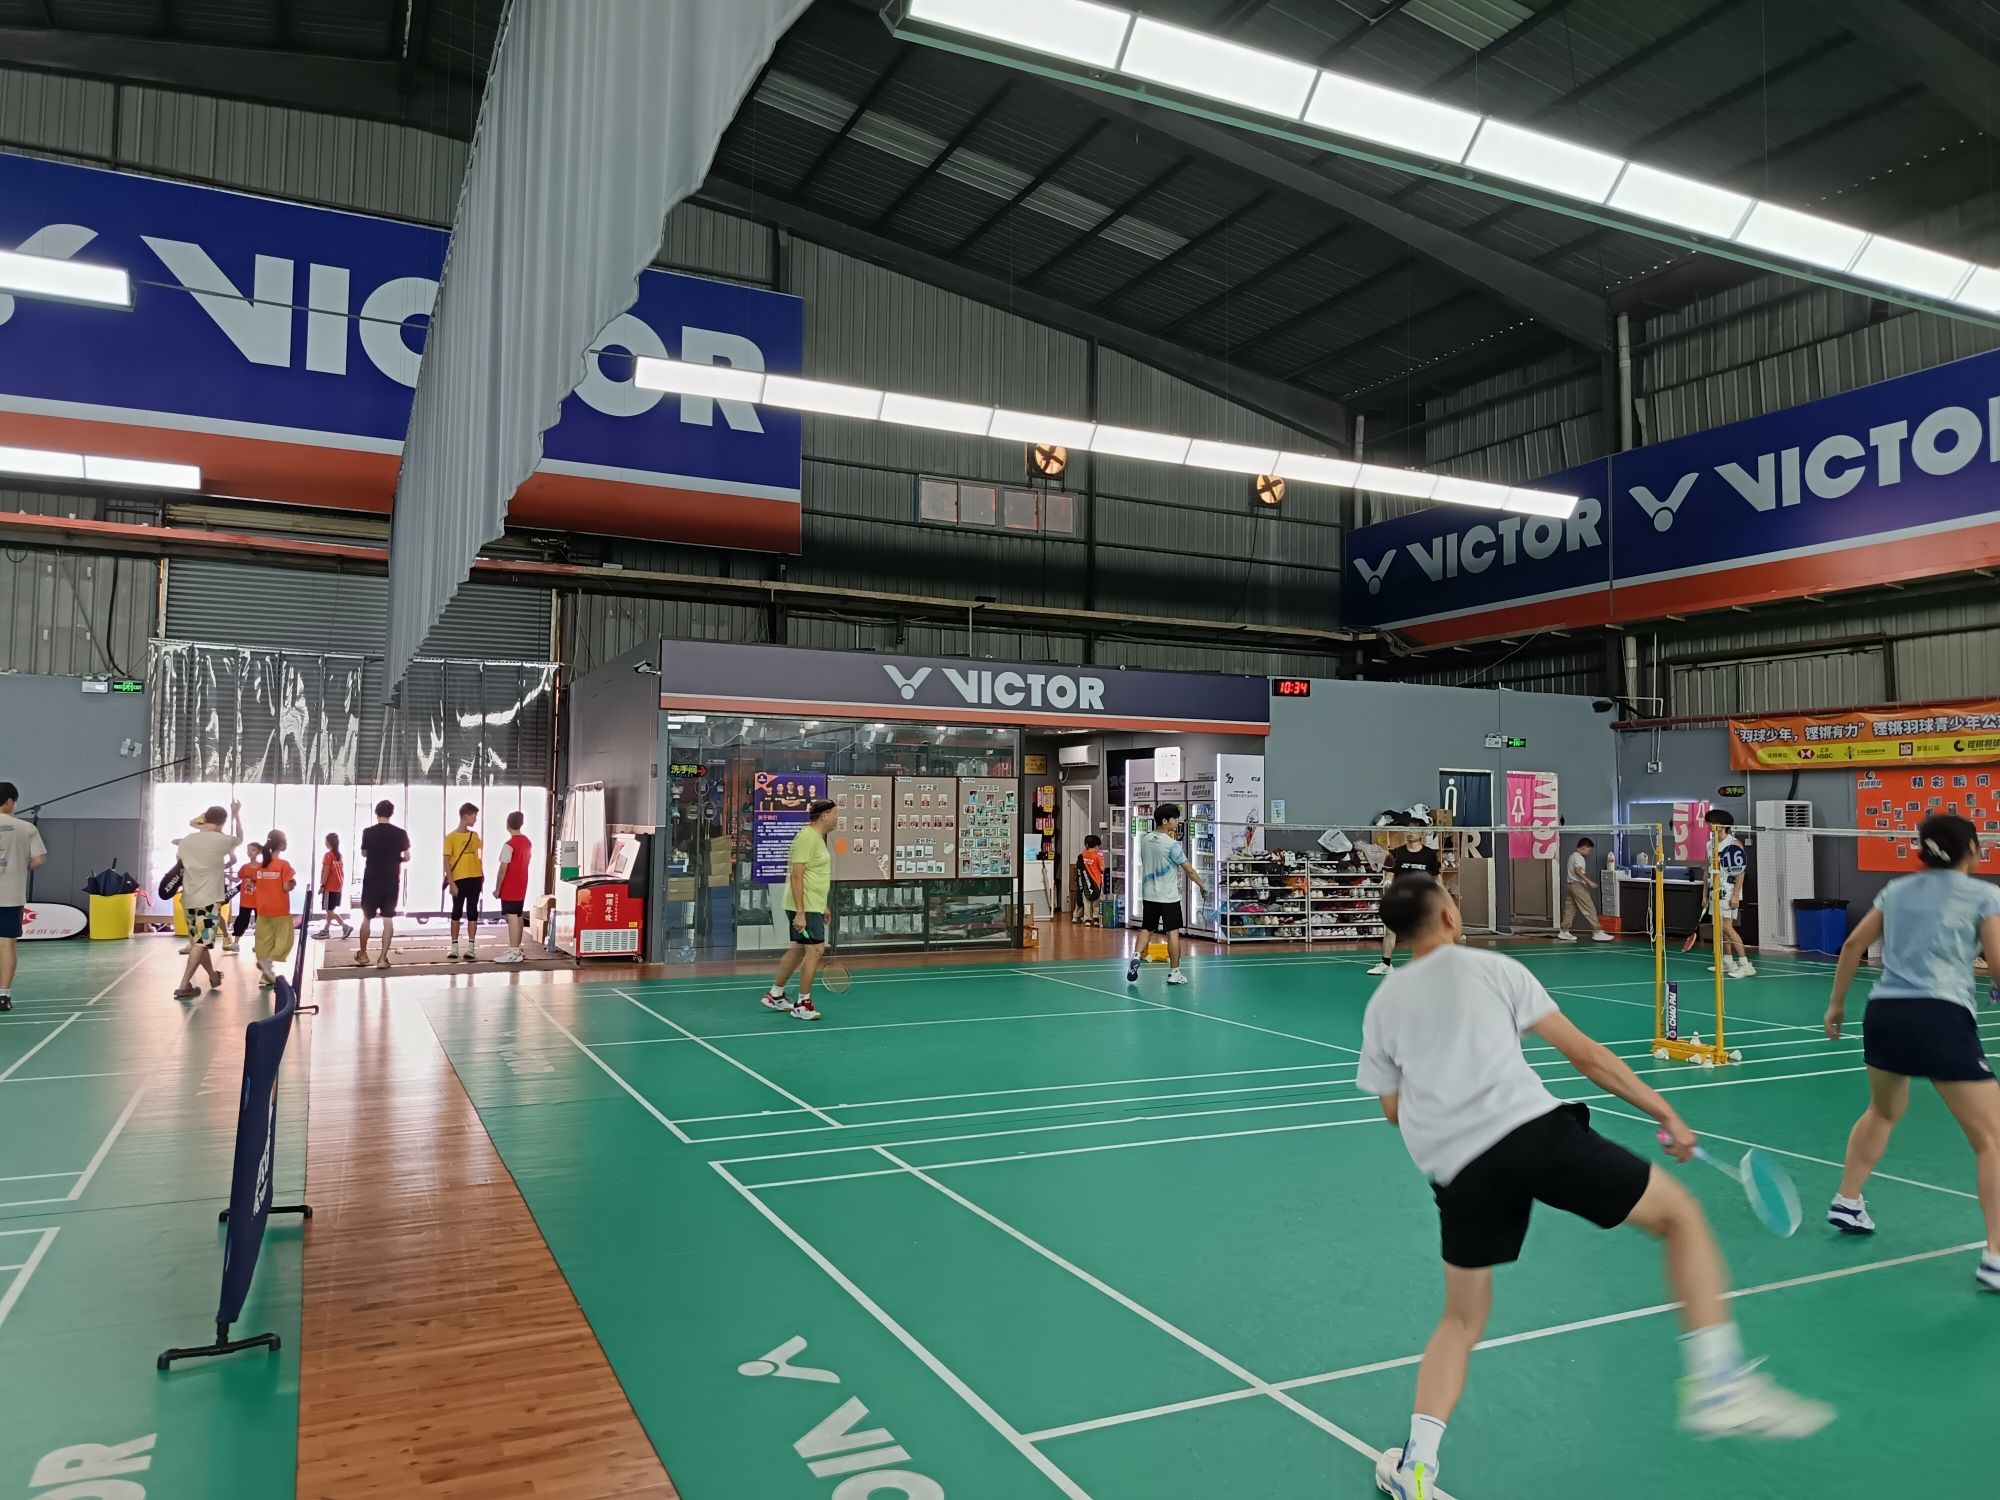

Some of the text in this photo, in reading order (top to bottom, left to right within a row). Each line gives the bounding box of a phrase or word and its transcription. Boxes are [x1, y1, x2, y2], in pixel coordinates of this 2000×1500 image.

[141, 235, 765, 434] VICOR
[1713, 395, 2000, 512] VICTO
[1406, 496, 1603, 582] VICTOR
[942, 667, 1105, 711] VICTOR
[1280, 681, 1308, 694] 10:34
[1873, 713, 2000, 737] 铿锵羽球青少年公
[1723, 851, 1744, 867] 16
